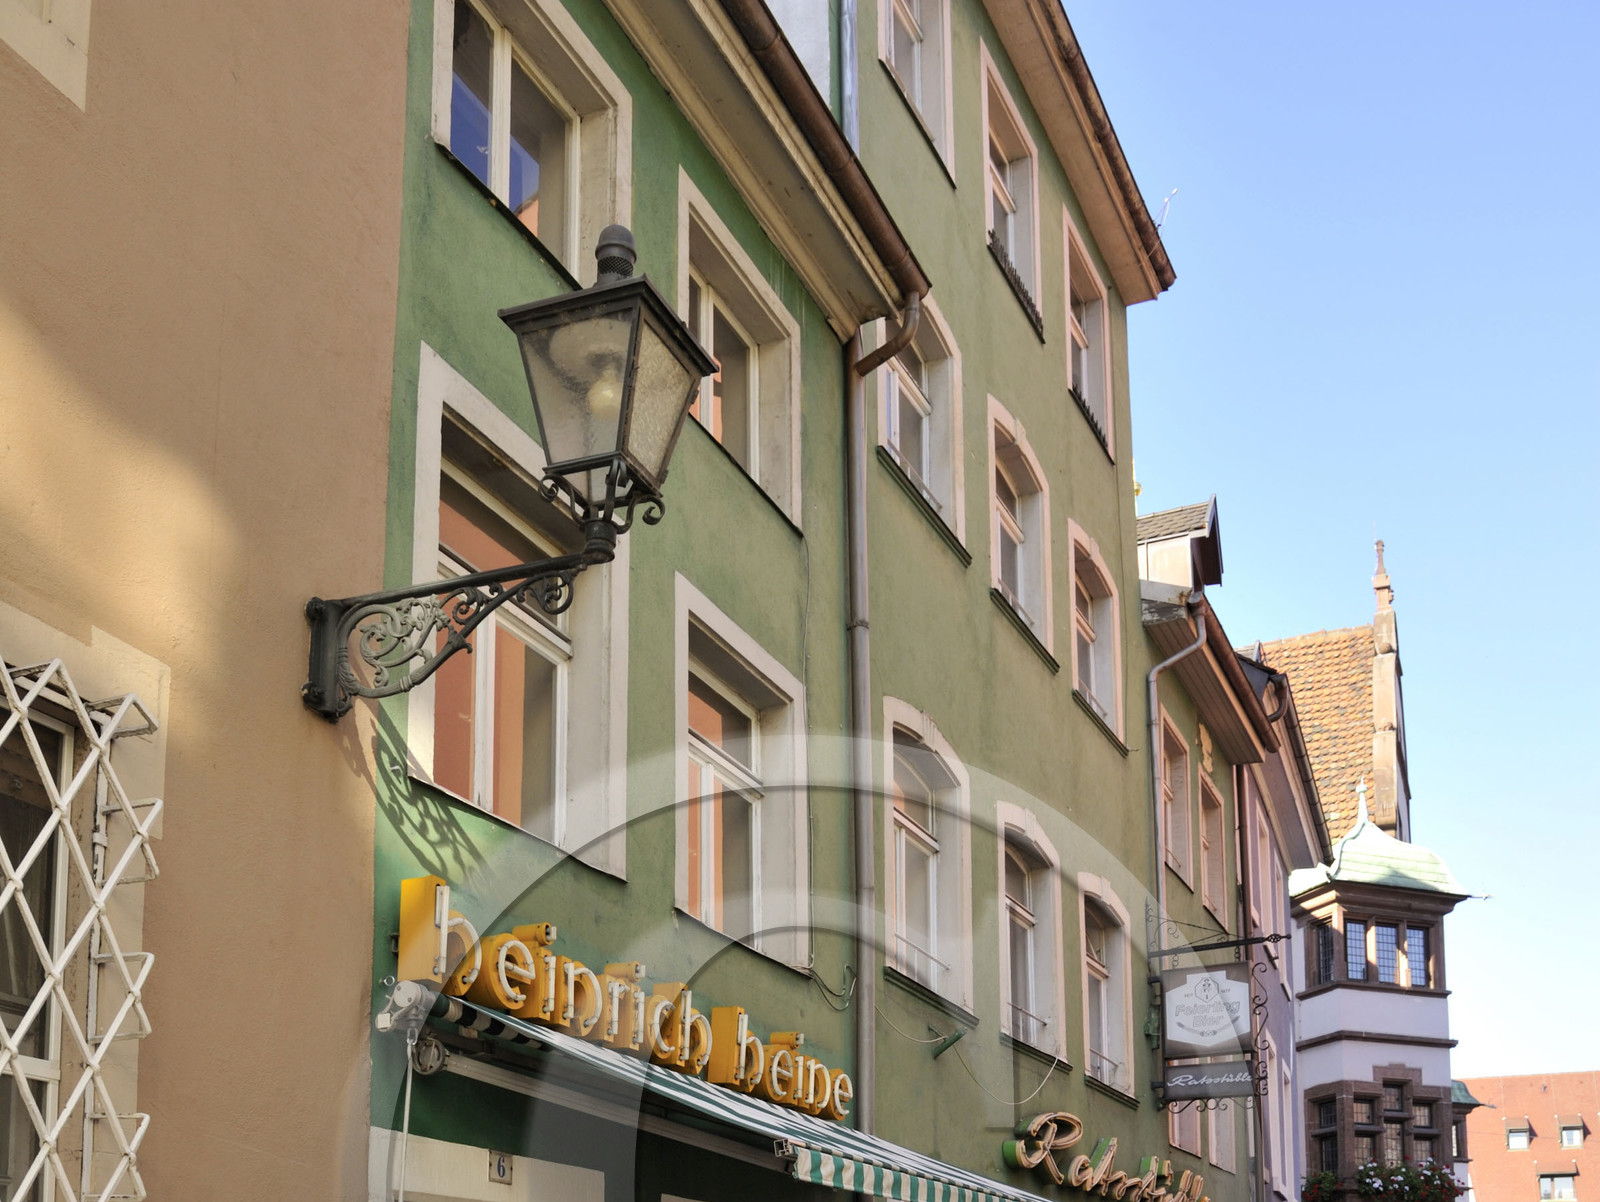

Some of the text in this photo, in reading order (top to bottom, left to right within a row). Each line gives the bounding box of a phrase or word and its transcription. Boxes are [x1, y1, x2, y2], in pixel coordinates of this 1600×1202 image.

[398, 875, 854, 1121] heinrich heine
[1175, 1000, 1241, 1017] Feierling
[1192, 1015, 1225, 1028] Bier
[496, 1156, 506, 1178] 6
